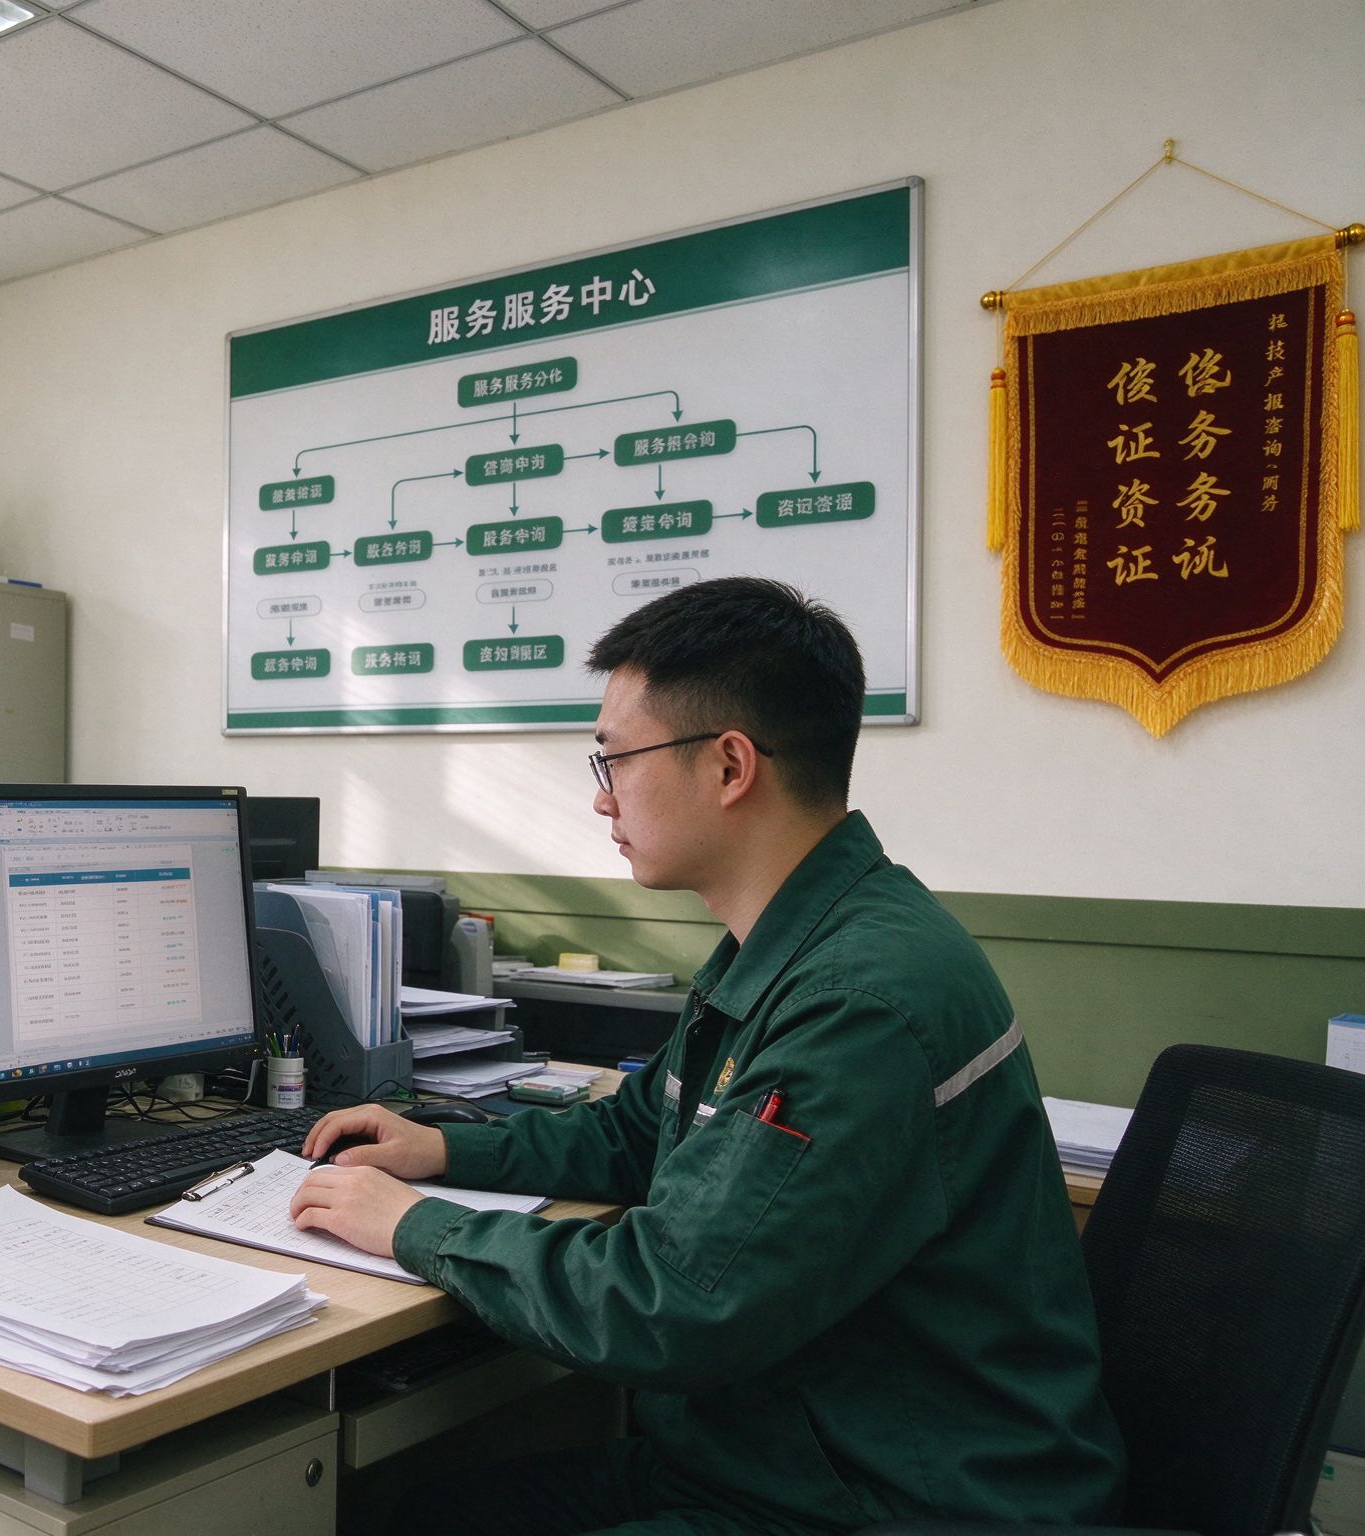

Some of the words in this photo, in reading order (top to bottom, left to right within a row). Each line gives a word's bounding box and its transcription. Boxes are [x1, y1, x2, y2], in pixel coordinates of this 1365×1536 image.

[427, 268, 656, 345] 服务服务中心
